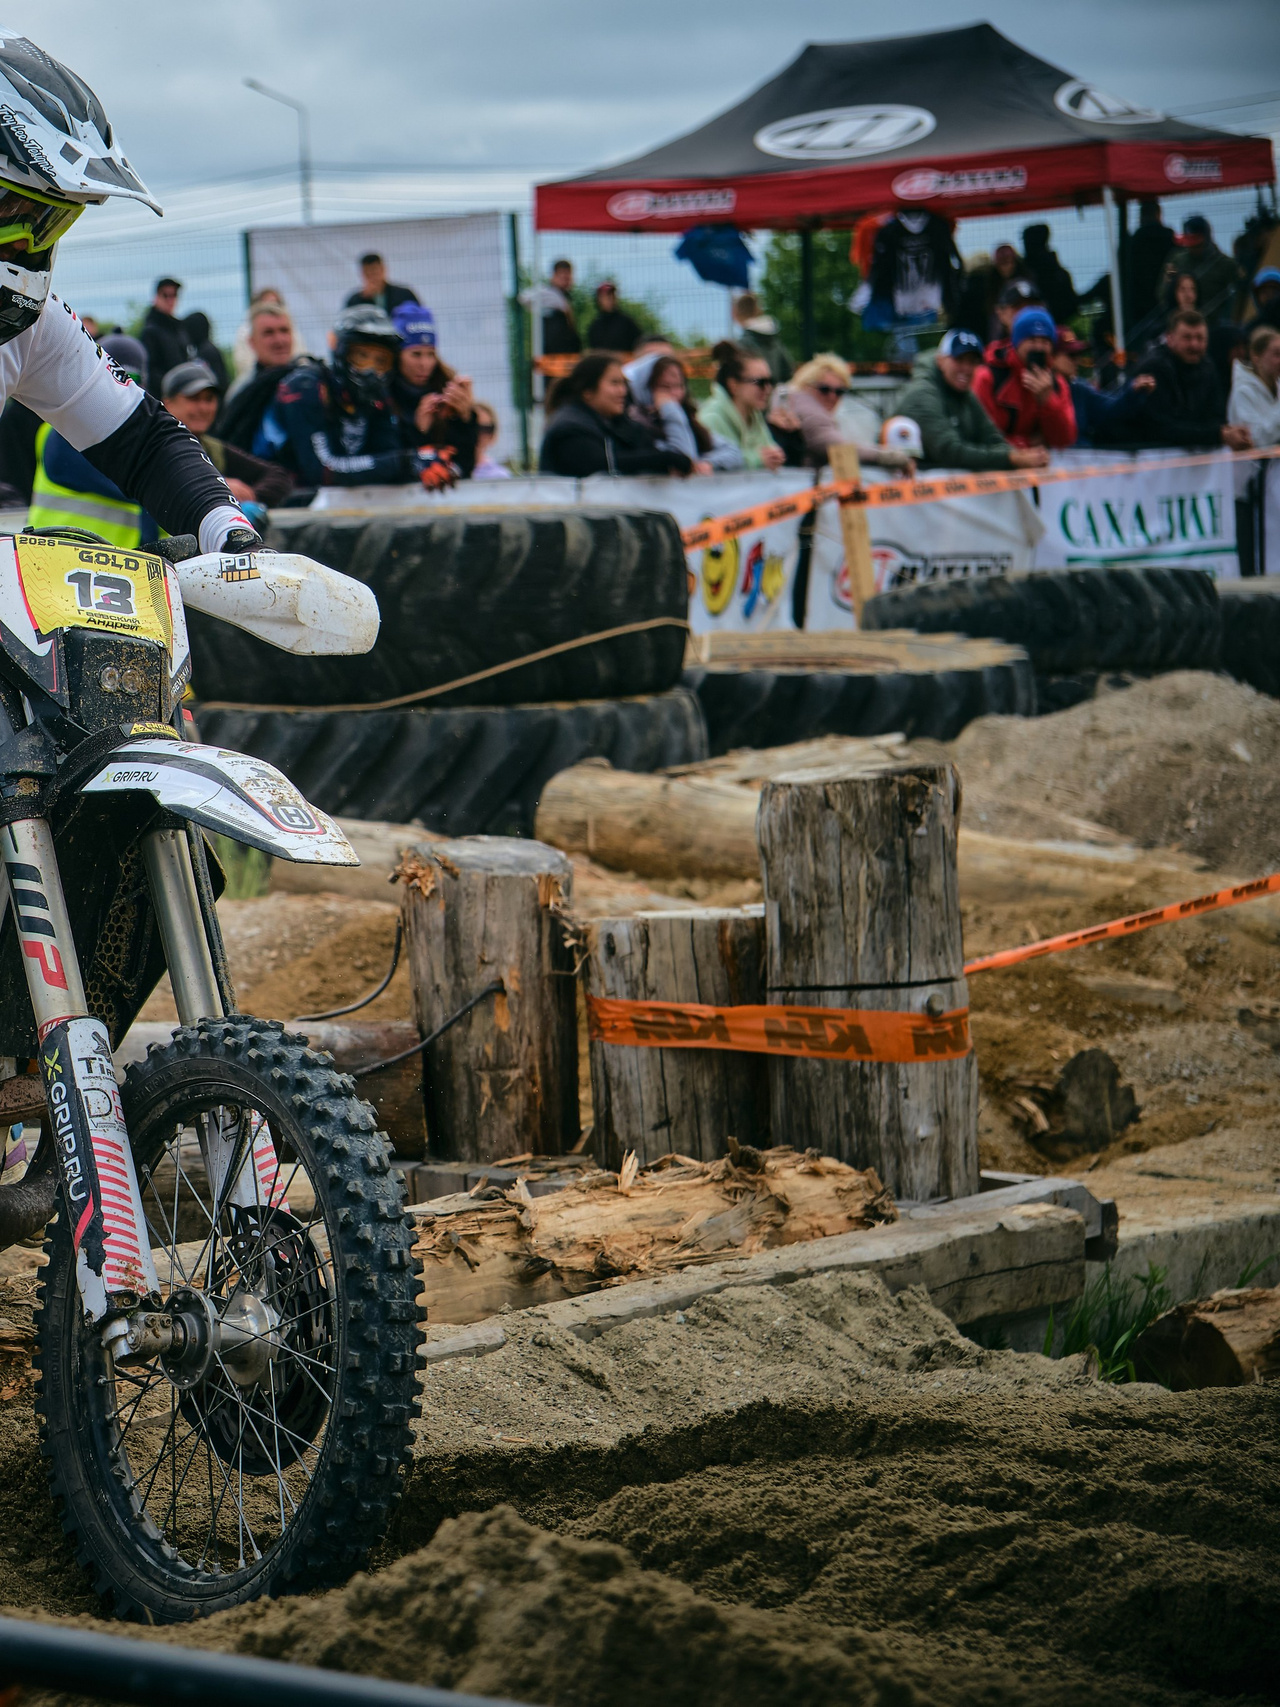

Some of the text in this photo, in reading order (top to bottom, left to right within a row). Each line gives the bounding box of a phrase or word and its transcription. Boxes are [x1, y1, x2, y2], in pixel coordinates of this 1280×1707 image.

[78, 550, 140, 572] GOLD
[65, 570, 136, 616] 13
[85, 616, 140, 632] Андрей
[101, 771, 160, 783] X-GRIP.RU
[43, 1047, 87, 1202] X-GRIP.RU
